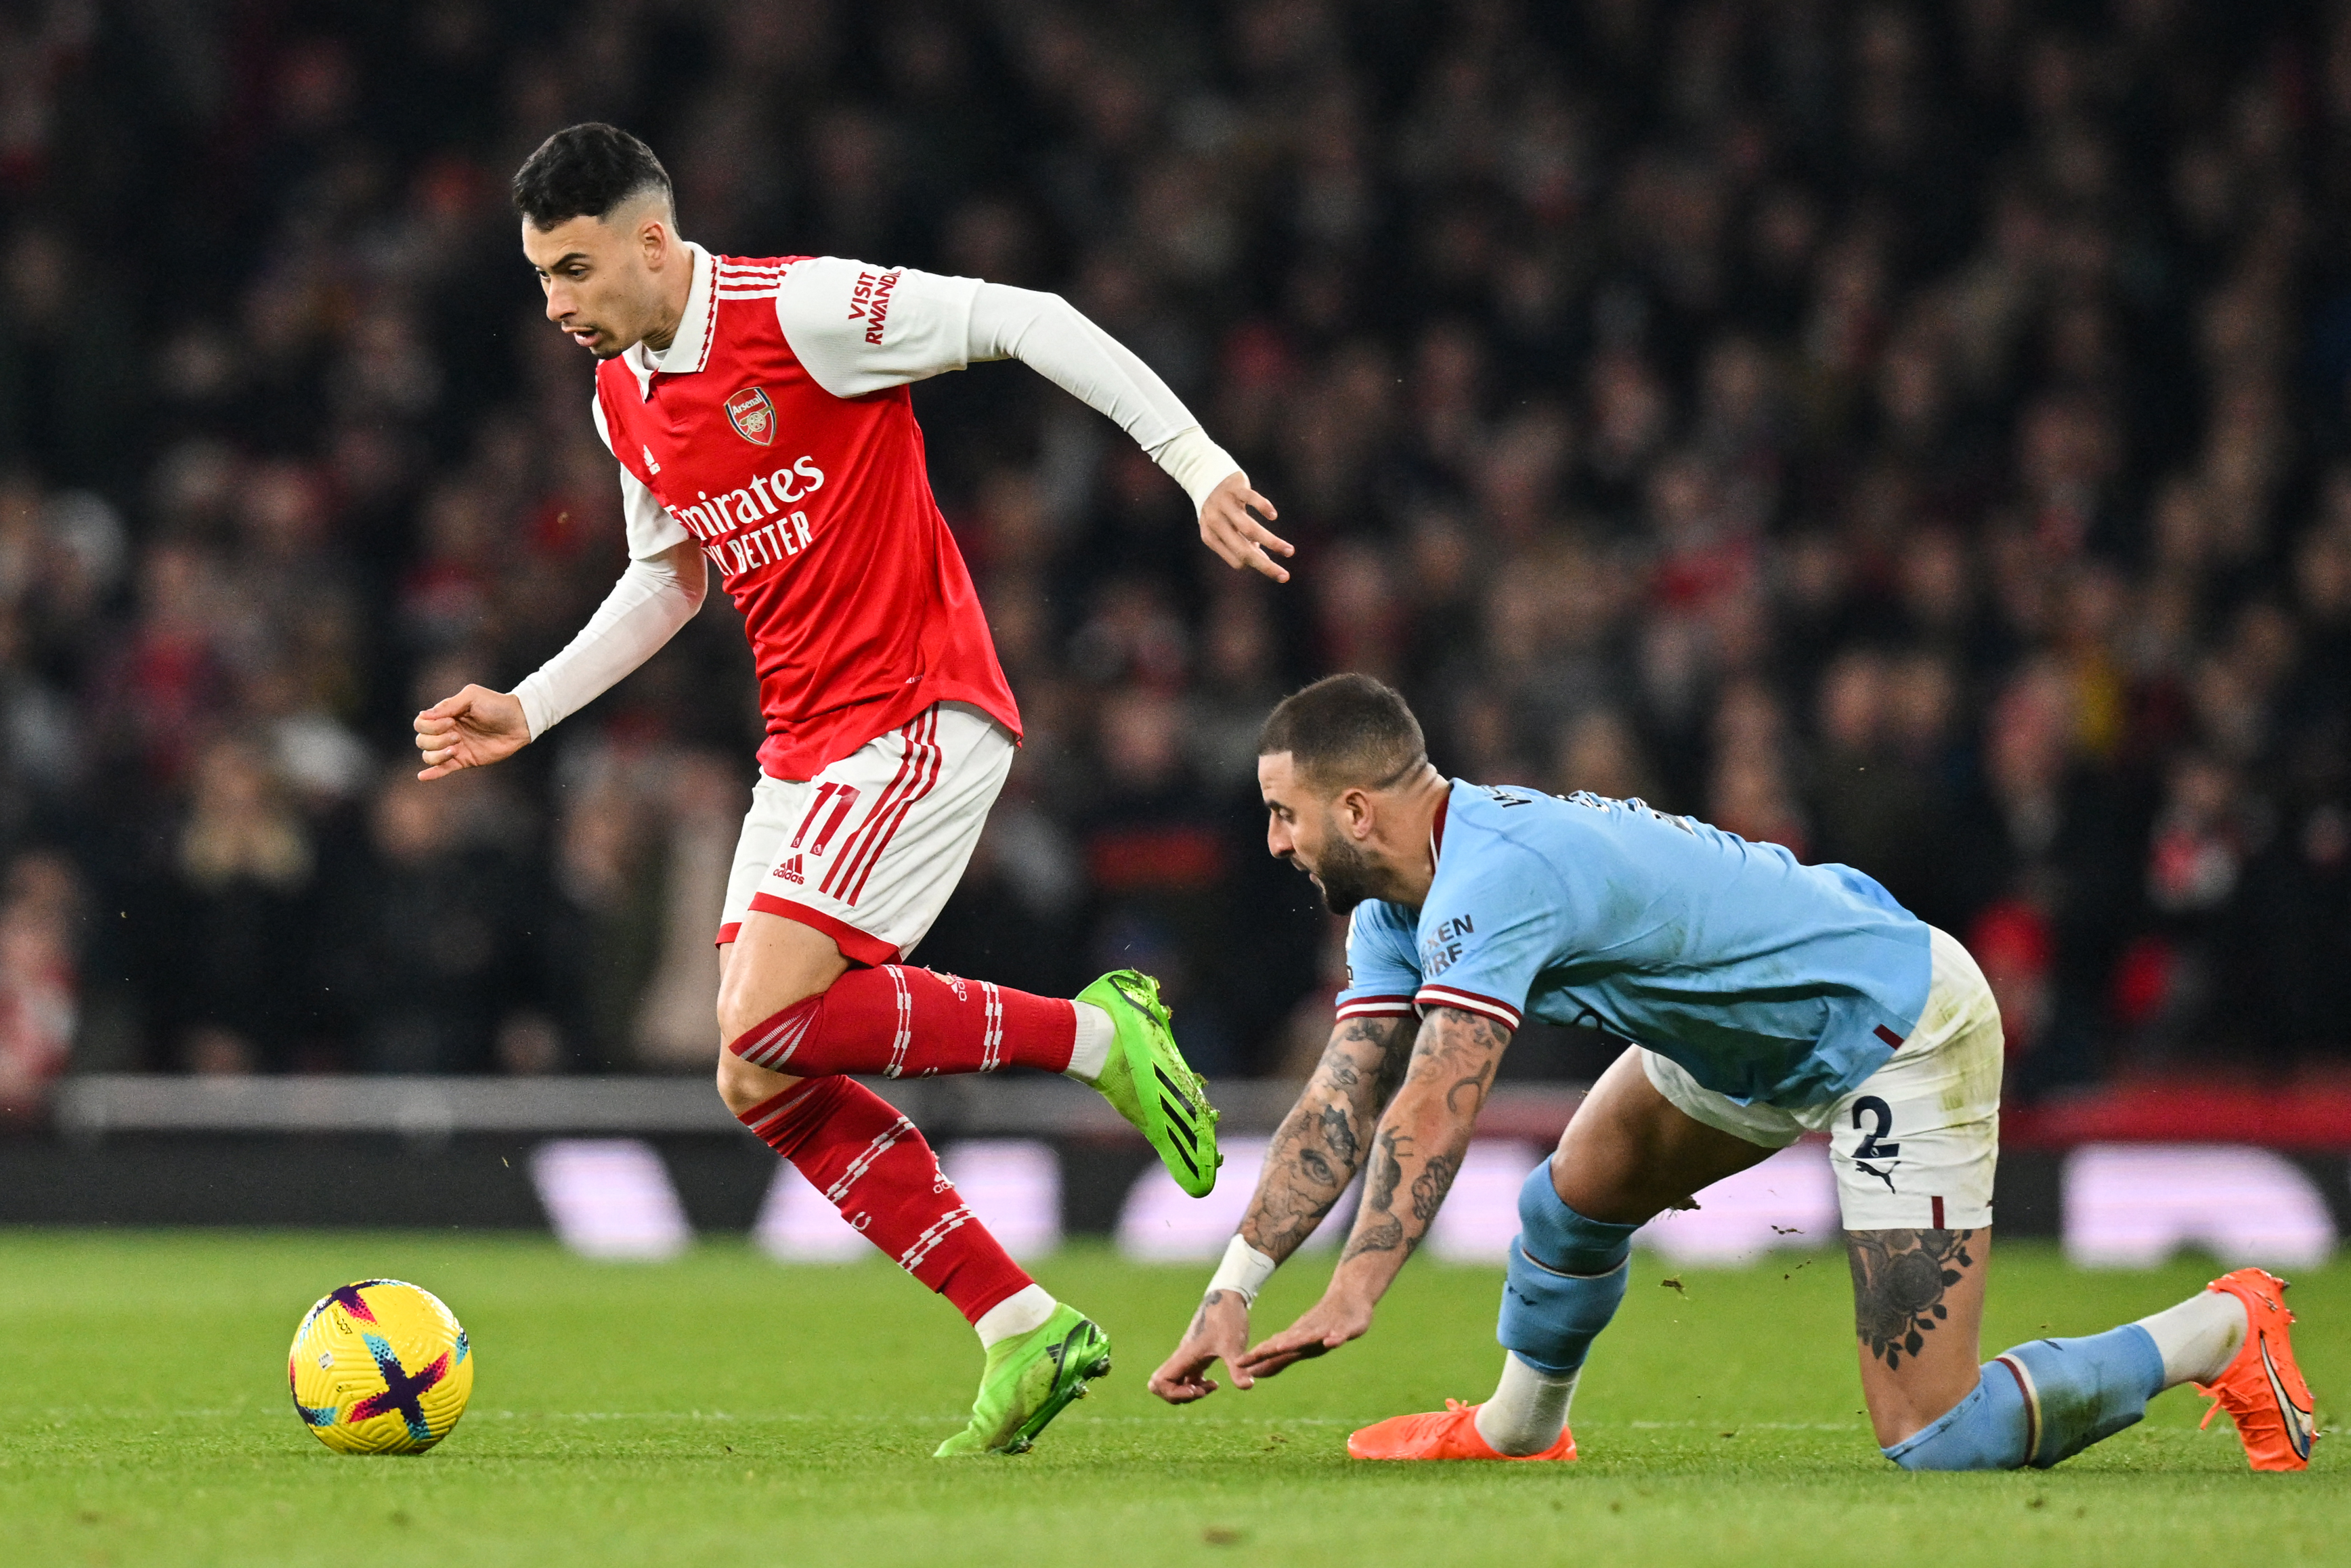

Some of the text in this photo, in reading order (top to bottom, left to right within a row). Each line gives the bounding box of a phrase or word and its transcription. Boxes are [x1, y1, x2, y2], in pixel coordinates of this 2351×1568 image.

[848, 271, 877, 320] VISIT
[732, 394, 763, 416] Arsenal
[727, 510, 813, 574] BETTER
[790, 781, 861, 856] 11
[773, 868, 805, 886] adidas
[1426, 914, 1474, 951] XEN
[1851, 1095, 1900, 1159] 2
